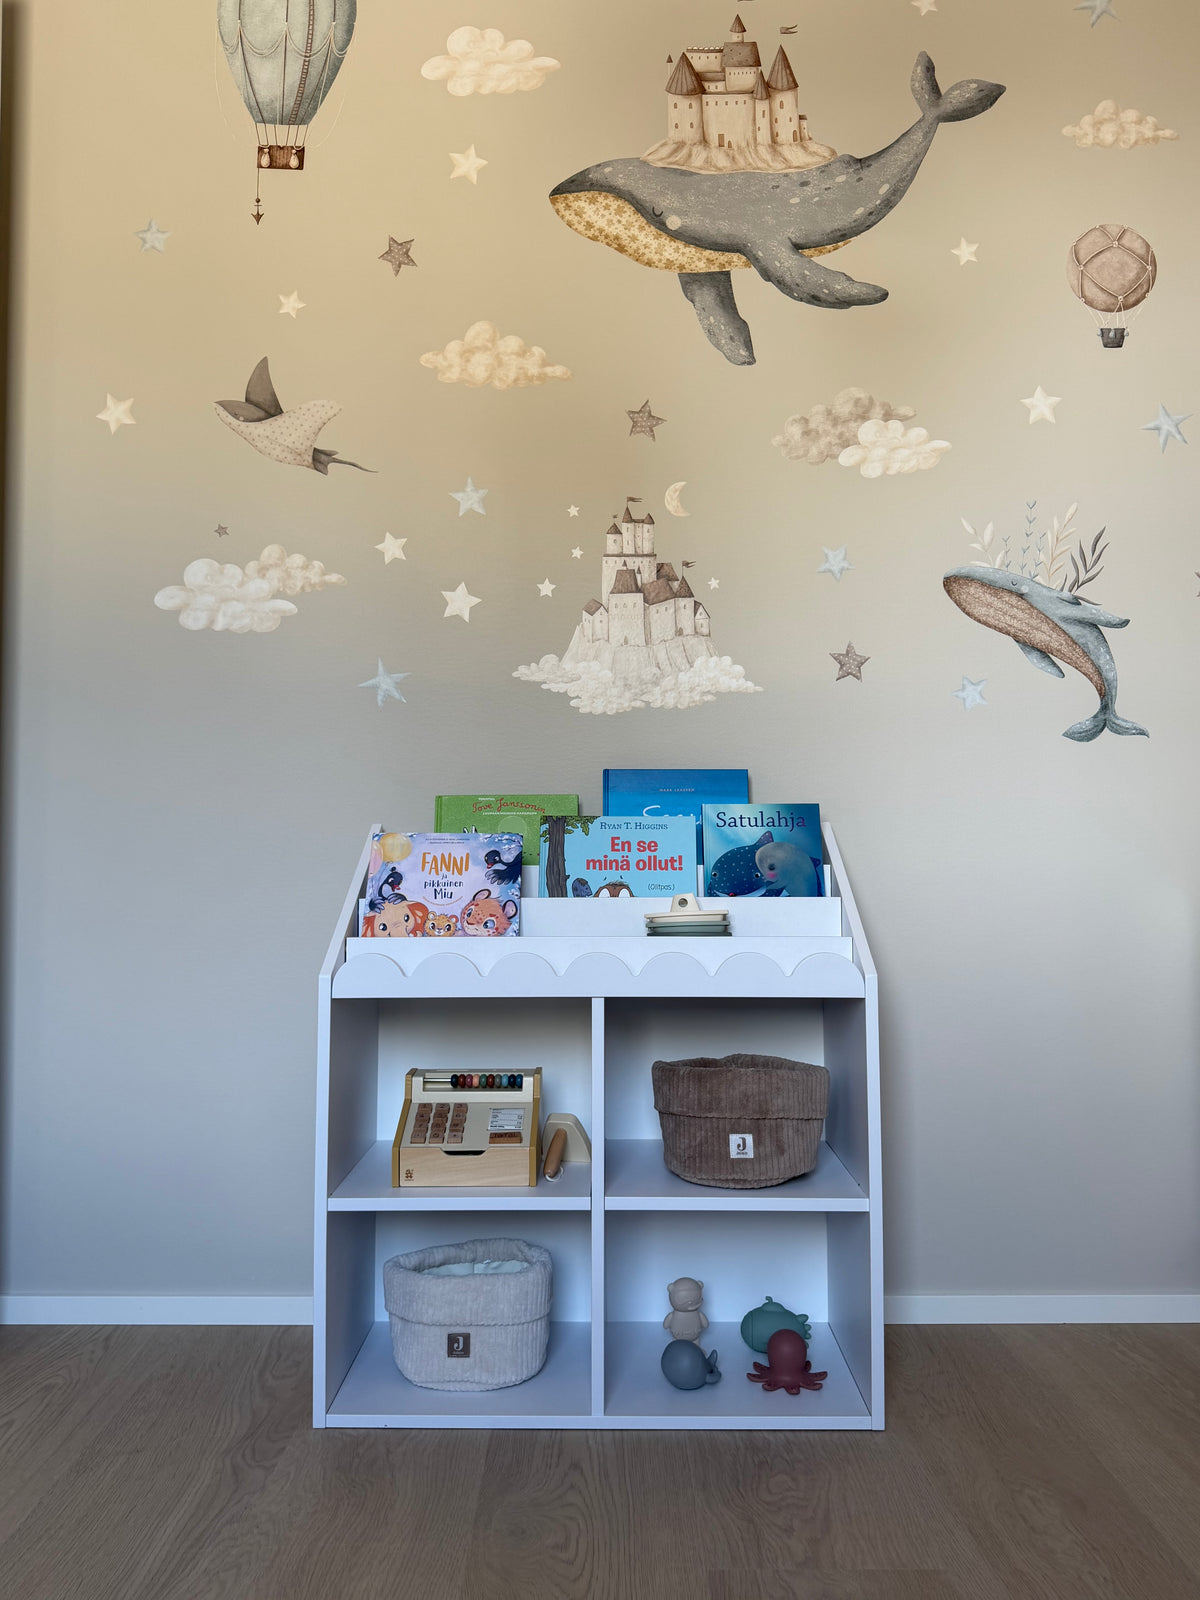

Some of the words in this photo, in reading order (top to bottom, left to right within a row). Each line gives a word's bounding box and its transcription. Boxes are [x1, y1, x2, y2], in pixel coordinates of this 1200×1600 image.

[472, 801, 494, 814] Tove
[495, 797, 546, 814] Janssonin
[624, 822, 633, 830] T.
[634, 822, 669, 830] HIGGINS
[716, 810, 807, 832] Satulahja
[610, 836, 632, 853] En
[636, 840, 659, 853] se
[421, 851, 470, 876] FANNI
[586, 854, 631, 871] minä
[635, 854, 684, 872] ollut!
[424, 879, 464, 889] pikkuinen
[433, 887, 454, 900] Miu
